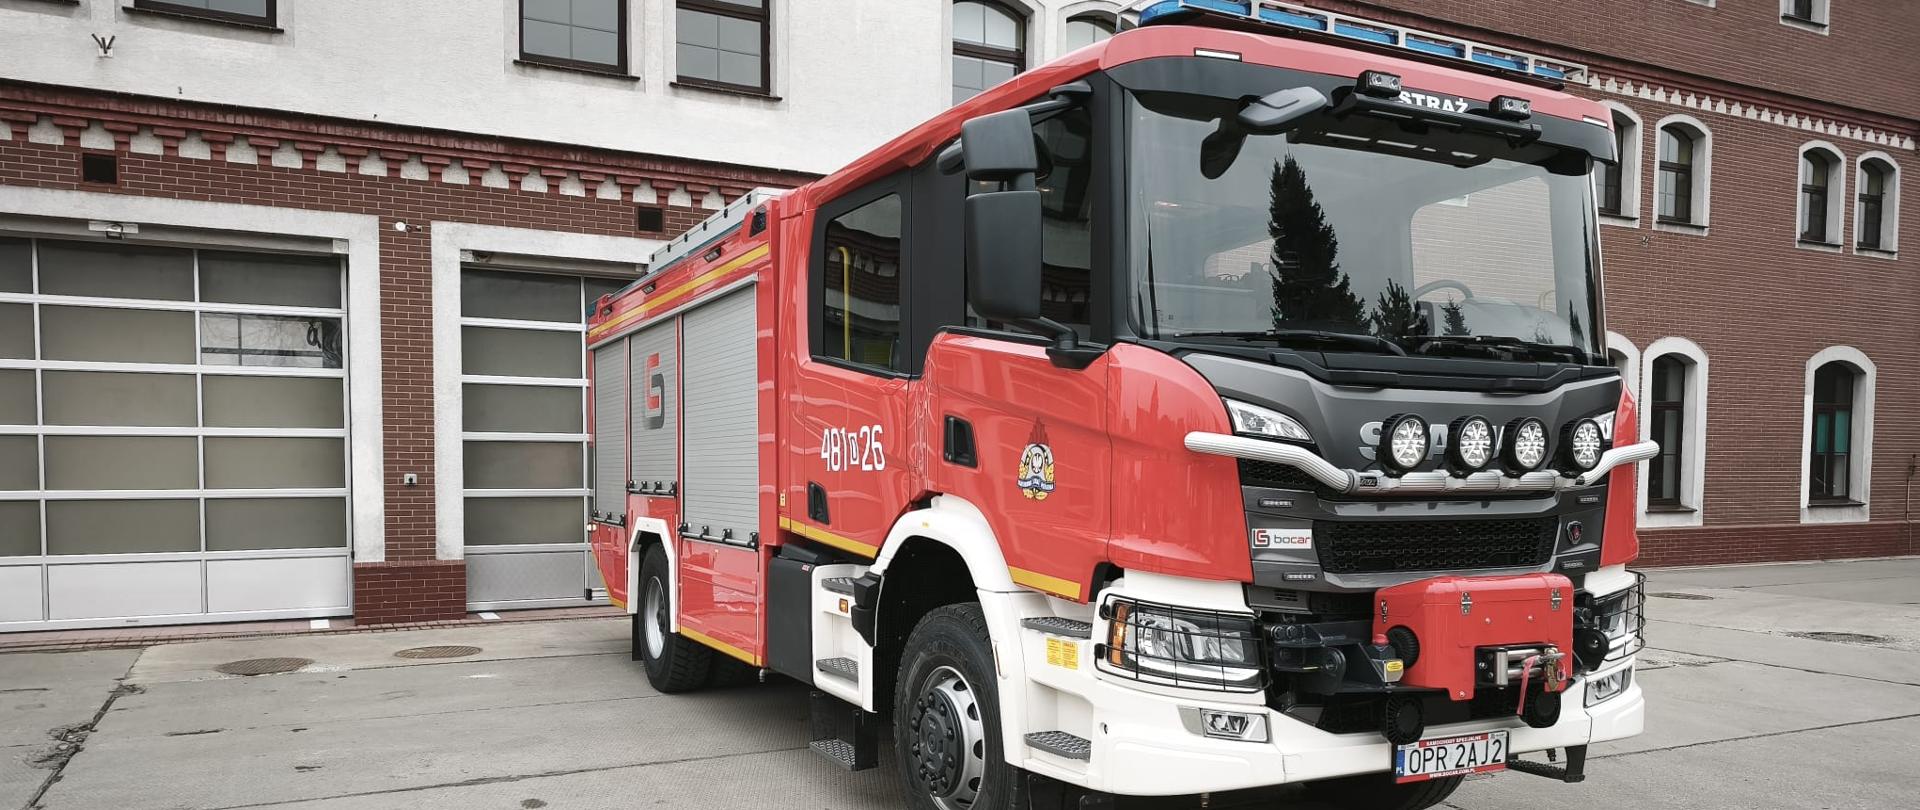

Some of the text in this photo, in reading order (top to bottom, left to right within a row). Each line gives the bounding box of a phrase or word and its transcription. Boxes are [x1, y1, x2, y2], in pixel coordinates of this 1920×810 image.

[1399, 91, 1468, 113] STRAŻ
[1274, 534, 1311, 544] bocar
[1409, 739, 1502, 773] OPR 2AJ2
